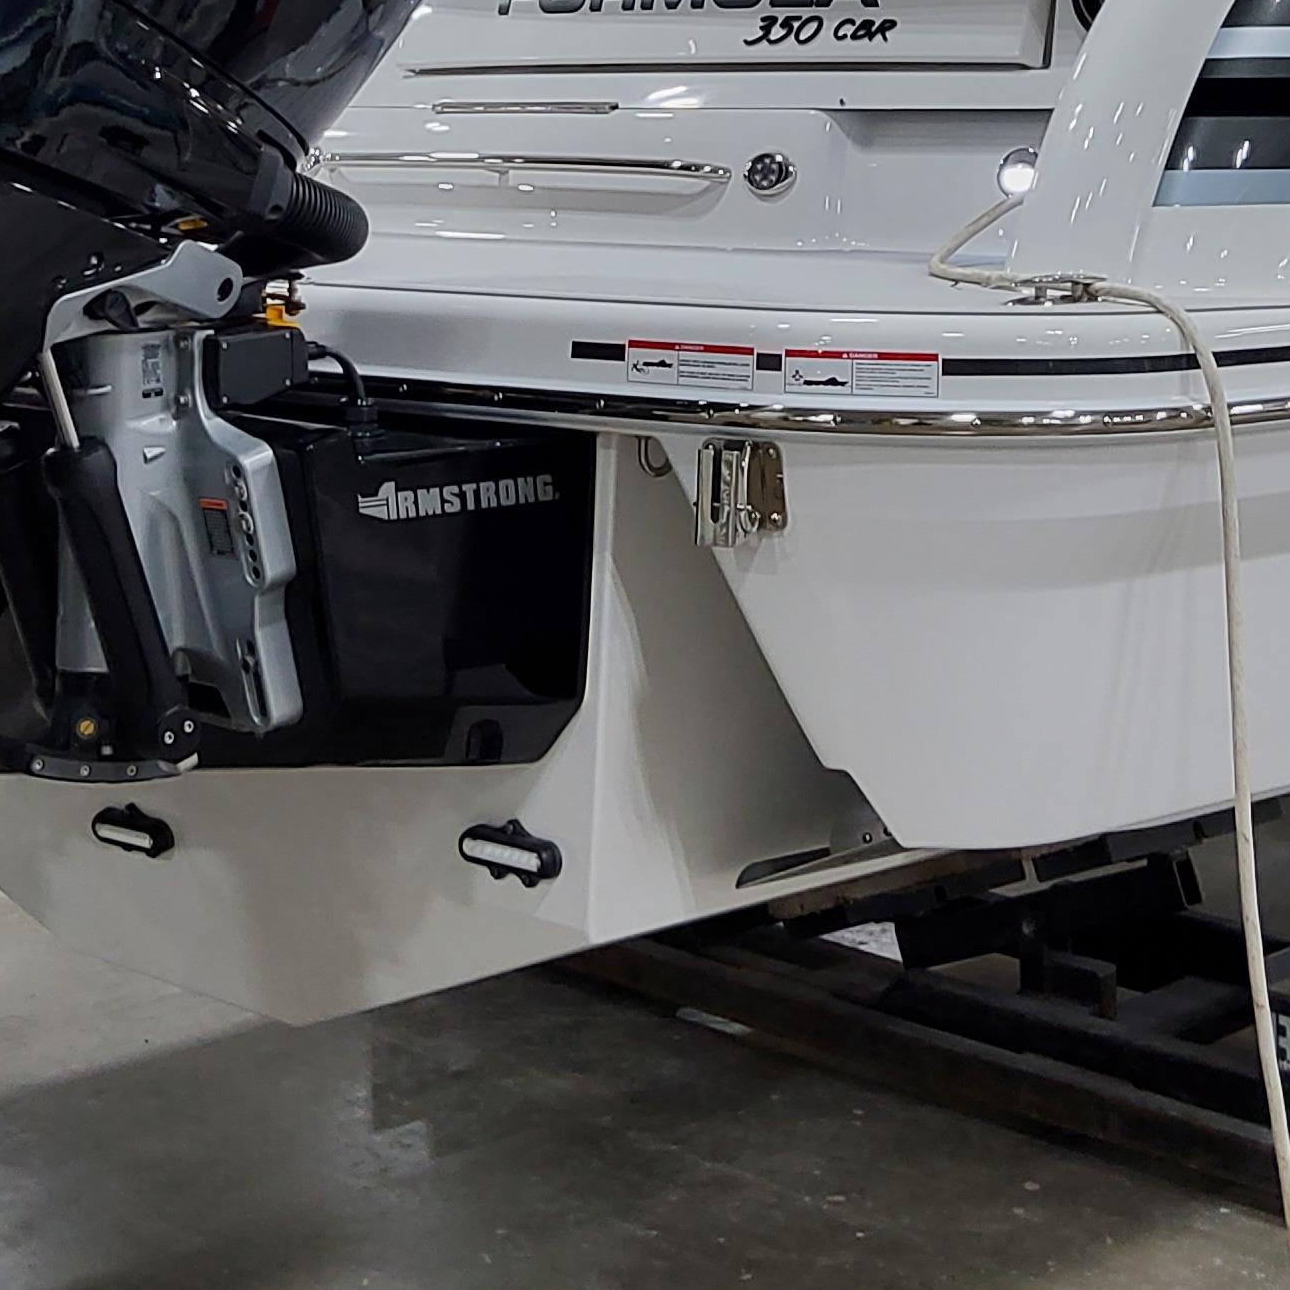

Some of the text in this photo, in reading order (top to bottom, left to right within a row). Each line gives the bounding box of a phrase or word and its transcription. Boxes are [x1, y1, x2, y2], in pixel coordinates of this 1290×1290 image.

[742, 14, 898, 47] 350 CBR
[357, 474, 555, 520] ARMSTRONG
